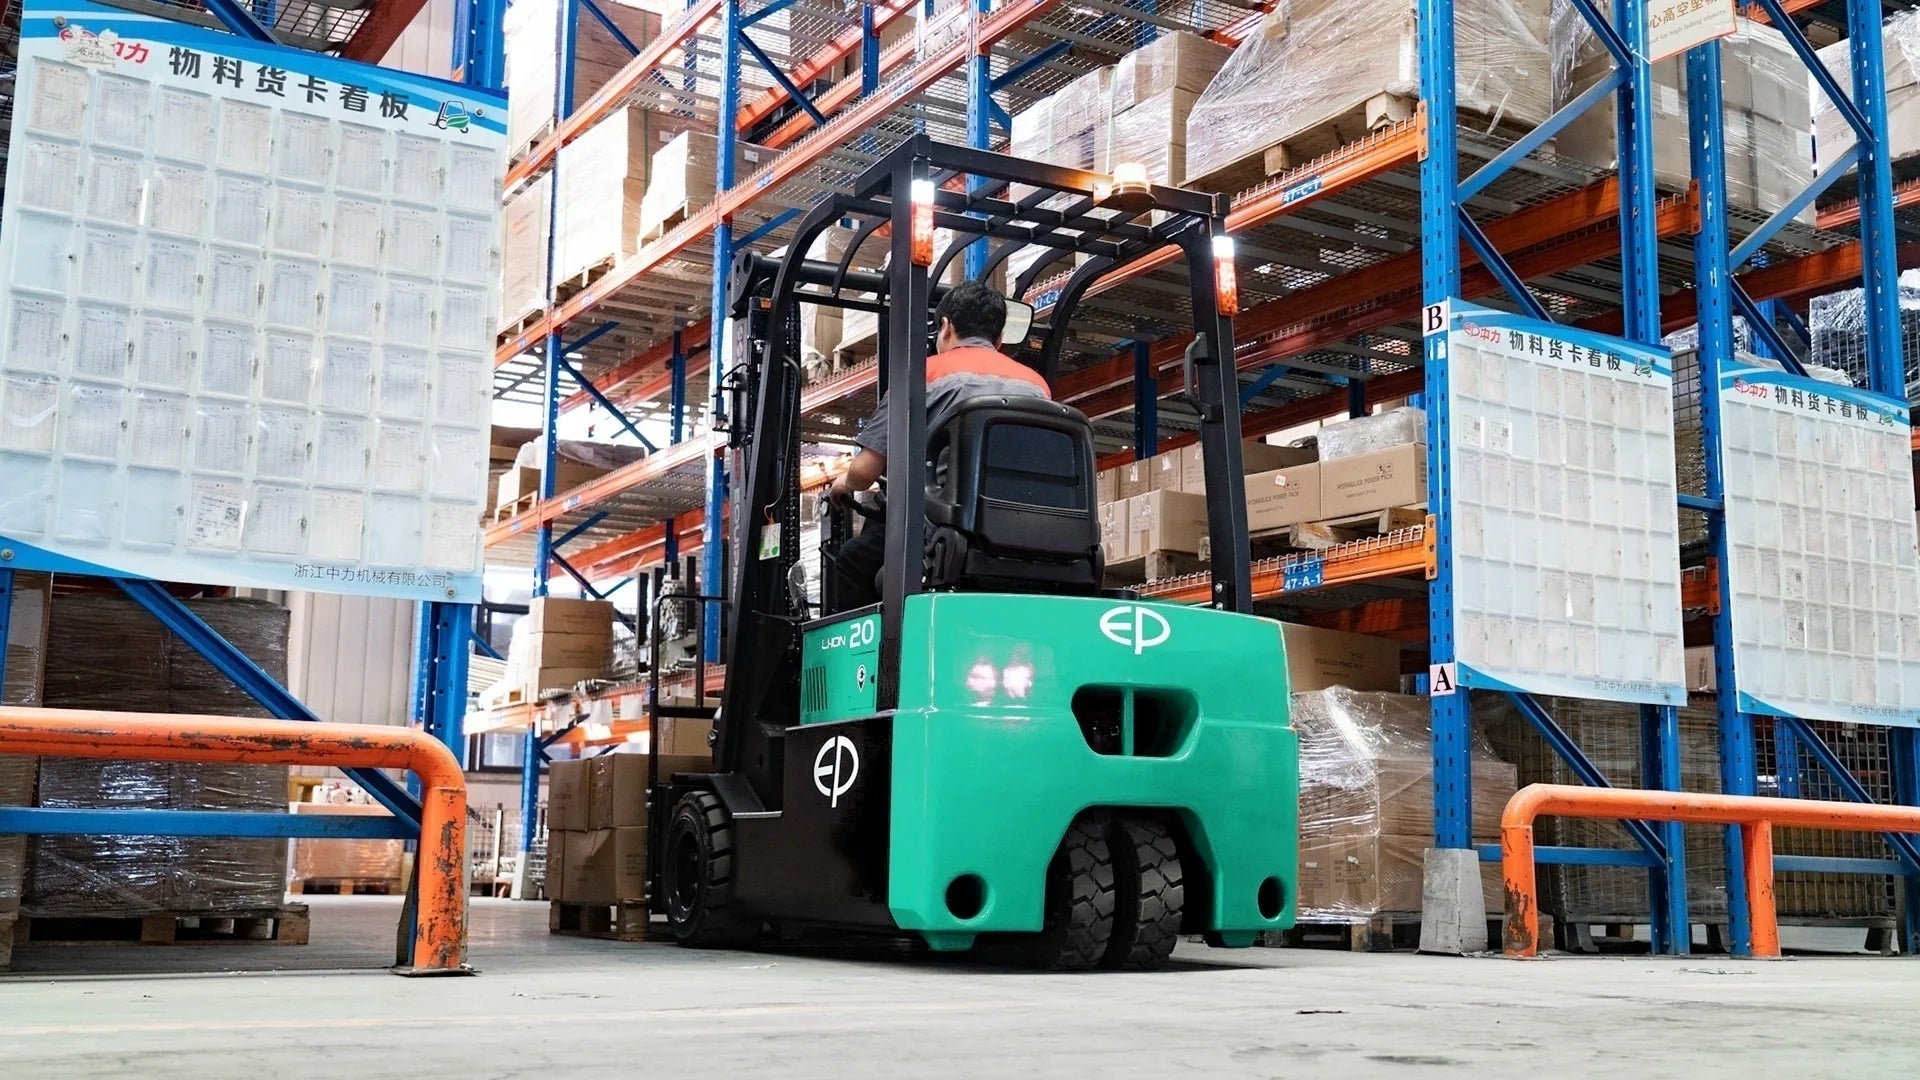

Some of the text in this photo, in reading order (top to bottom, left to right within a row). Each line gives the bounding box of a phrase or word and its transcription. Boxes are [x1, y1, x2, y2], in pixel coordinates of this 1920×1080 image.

[169, 46, 409, 121] 物料货卡看板
[1426, 305, 1443, 332] B
[1509, 330, 1622, 372] 物料货卡看板
[1775, 385, 1869, 421] 物料货卡看板
[294, 563, 446, 588] 浙江中力机械有限公司
[1284, 573, 1321, 590] 47-A-1
[849, 619, 875, 649] 20
[1100, 606, 1171, 655] EP
[1433, 665, 1453, 691] A
[813, 735, 859, 808] EP
